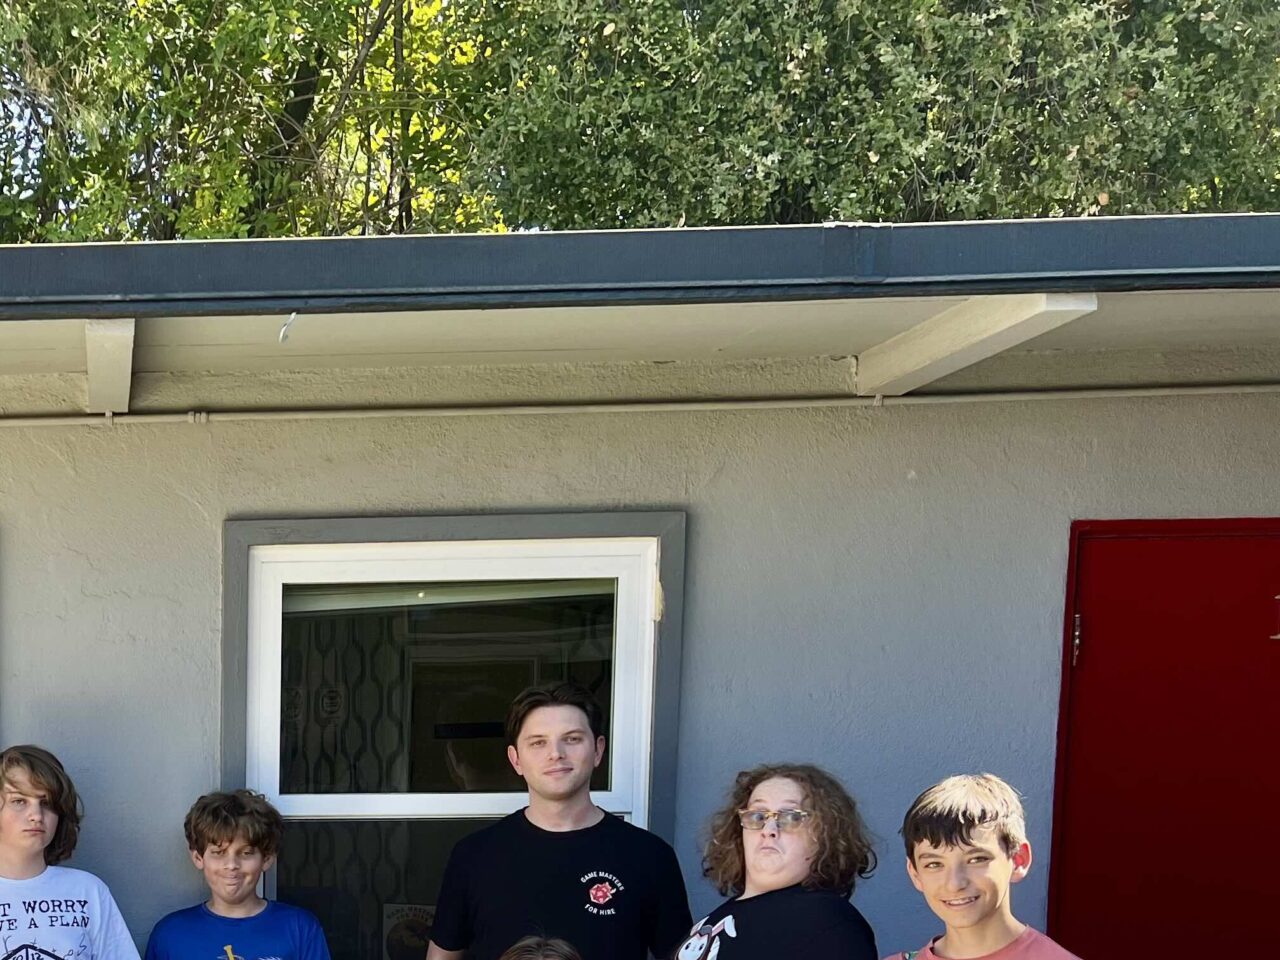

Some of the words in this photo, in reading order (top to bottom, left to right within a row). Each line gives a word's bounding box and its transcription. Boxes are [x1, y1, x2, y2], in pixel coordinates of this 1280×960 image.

[580, 871, 597, 883] GAME
[598, 871, 625, 891] MASTERS
[22, 899, 89, 914] WORRY
[584, 903, 598, 914] FOR
[599, 908, 616, 916] HIRE
[27, 917, 39, 929] A
[48, 915, 90, 929] PLAN
[31, 952, 44, 960] 12
